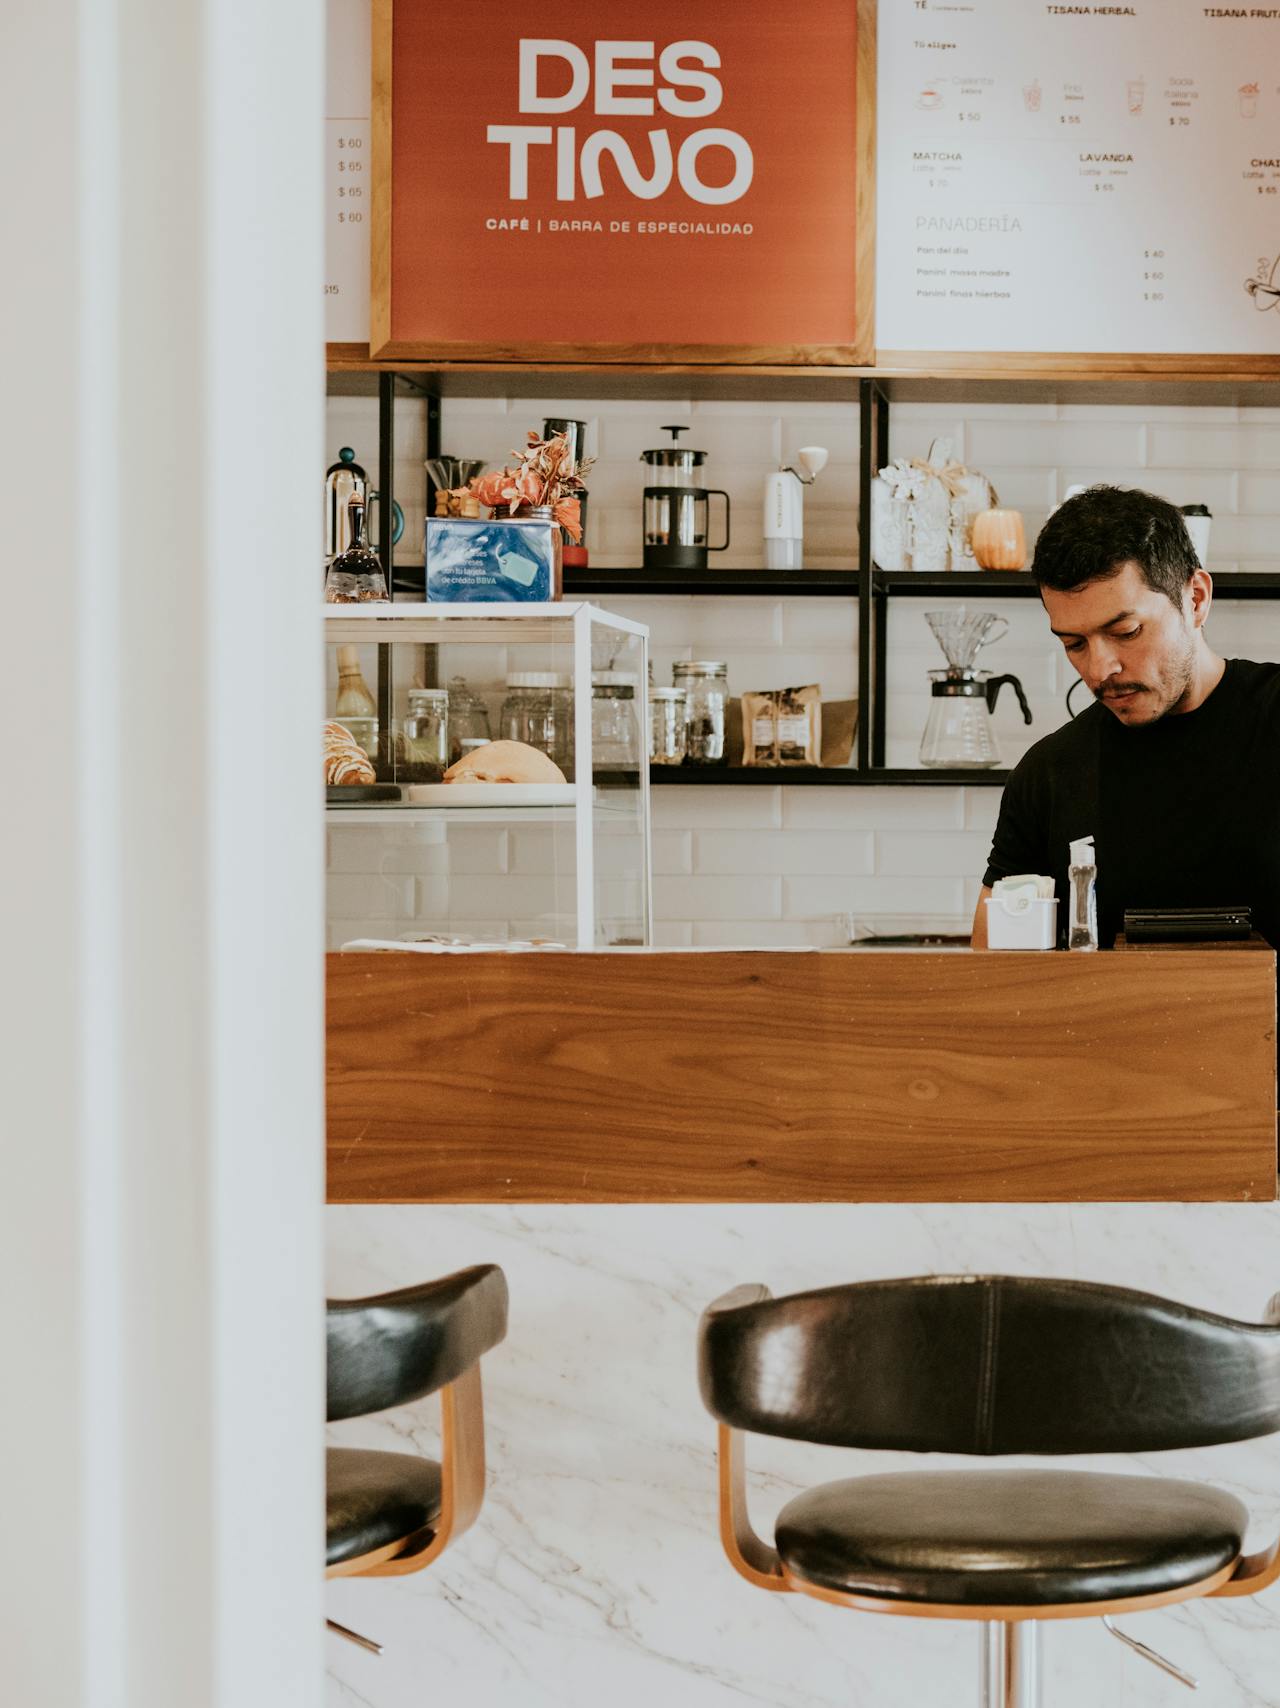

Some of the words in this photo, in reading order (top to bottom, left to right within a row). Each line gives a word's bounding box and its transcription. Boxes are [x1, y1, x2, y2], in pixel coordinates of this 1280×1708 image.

[1046, 6, 1090, 14] TISANA
[1094, 7, 1136, 16] HERBAL
[1203, 9, 1248, 18] TISANA
[518, 38, 723, 118] DES
[348, 138, 362, 149] 60
[913, 152, 963, 161] MATCHA
[1079, 153, 1134, 162] LAVANDA
[348, 161, 362, 172] 65
[486, 124, 754, 206] TINO
[1251, 159, 1280, 168] CHAI
[348, 212, 362, 223] 60
[916, 213, 1023, 232] PANADERÍA
[486, 217, 530, 231] CAFÉ
[549, 220, 603, 232] BARRA
[609, 221, 631, 233] DE
[637, 222, 754, 235] ESPECIALIDAD
[917, 246, 935, 255] Pan
[917, 268, 946, 277] Panini
[978, 269, 1010, 278] madre
[917, 289, 946, 297] Panini
[950, 289, 973, 298] finas
[976, 290, 1011, 299] hierbas
[475, 577, 497, 585] BBVA
